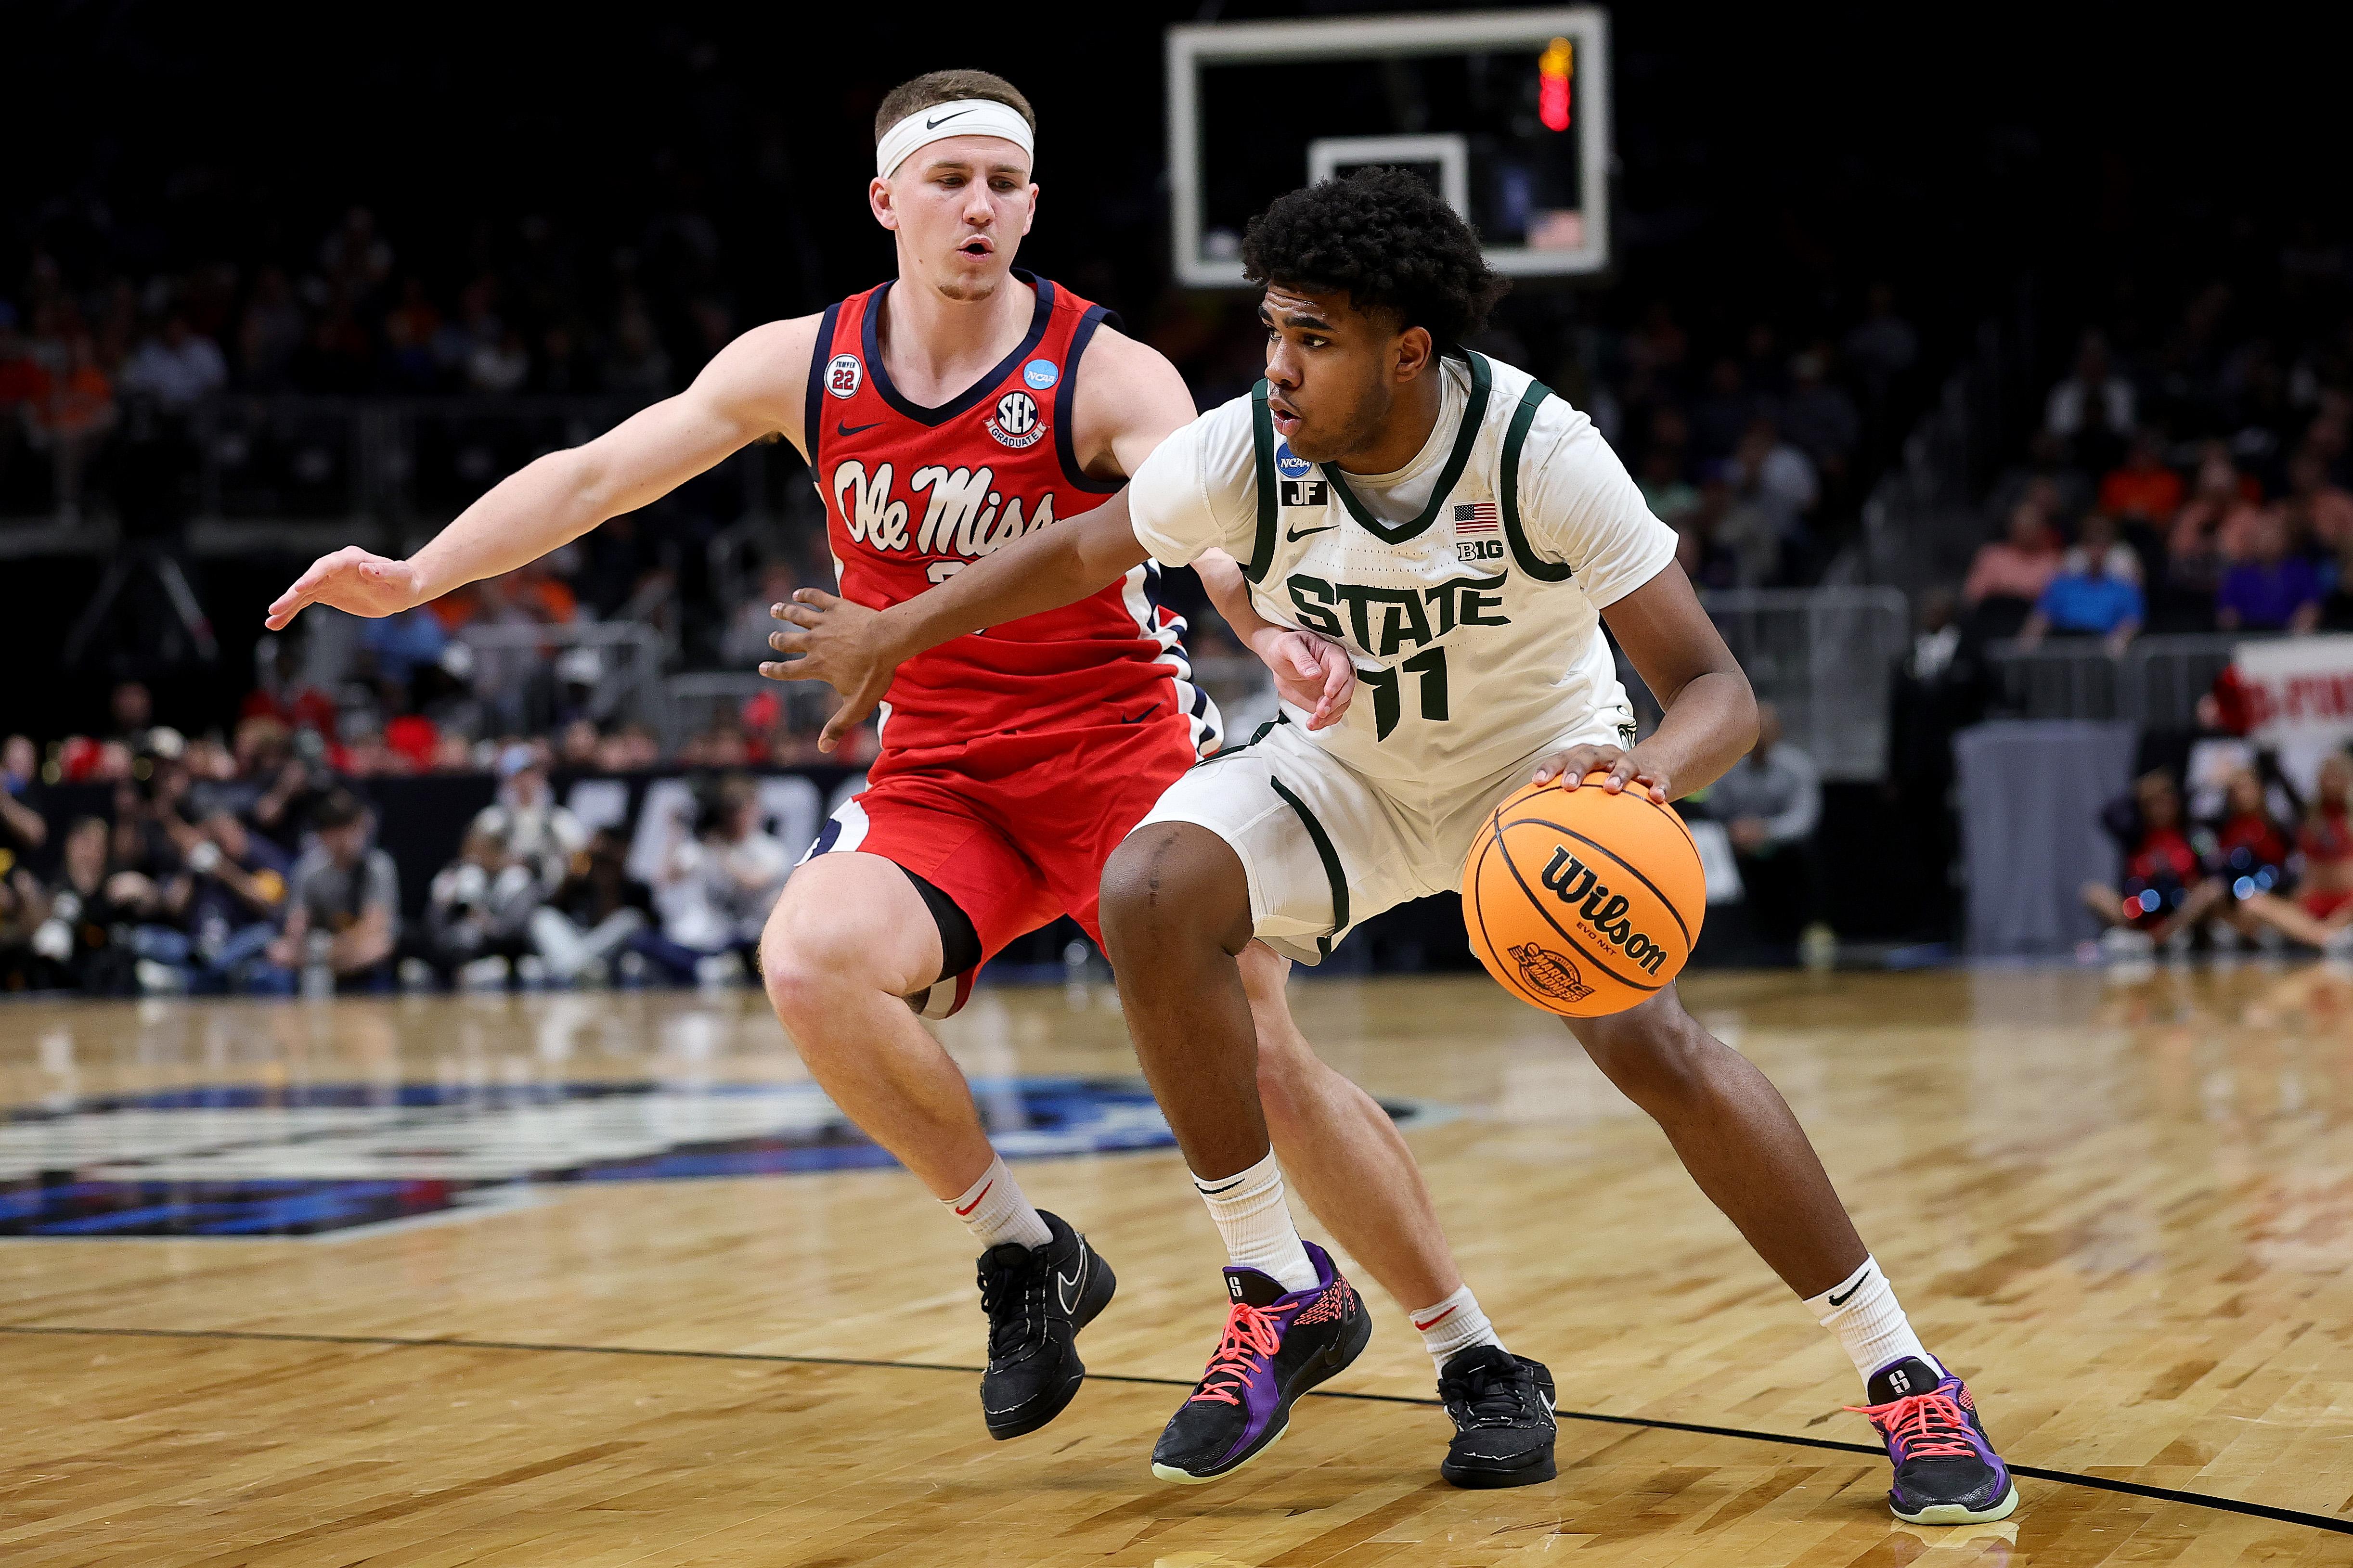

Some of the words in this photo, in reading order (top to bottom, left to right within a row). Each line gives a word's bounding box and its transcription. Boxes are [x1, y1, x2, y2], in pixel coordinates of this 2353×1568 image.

[832, 369, 854, 390] 22
[1027, 371, 1055, 383] NCAA
[998, 393, 1035, 433] SEC
[992, 428, 1039, 447] GRADUATE
[1280, 458, 1310, 468] NCAA
[834, 459, 909, 551] Ole
[1291, 482, 1318, 505] JF
[1287, 568, 1511, 657] STATE
[1356, 646, 1449, 742] 11
[1541, 843, 1668, 977] Wilson
[1577, 922, 1597, 939] EVO
[1597, 939, 1616, 956] NXT
[1532, 954, 1574, 988] MARCH
